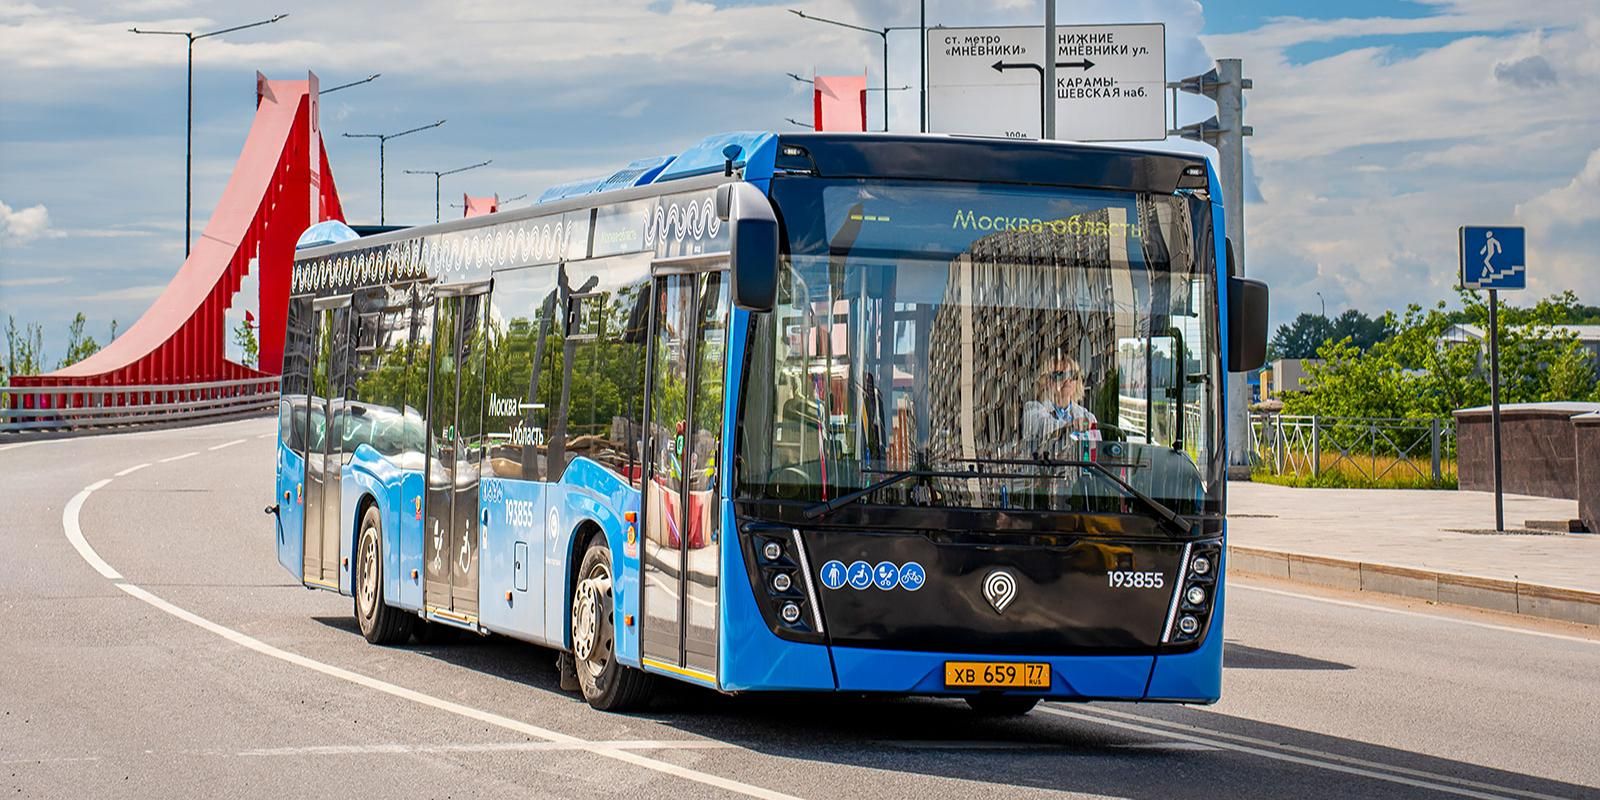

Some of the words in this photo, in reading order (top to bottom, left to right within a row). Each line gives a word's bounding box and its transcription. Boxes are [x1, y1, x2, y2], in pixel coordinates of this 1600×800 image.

[945, 36, 960, 44] ст.
[965, 35, 1000, 46] метро
[1058, 33, 1114, 44] НИЖНИЕ
[1132, 46, 1149, 57] ул.
[1057, 77, 1118, 88] КАРАМЫ-
[1057, 88, 1120, 99] ШЕВСКАЯ
[1124, 87, 1148, 98] наб.
[488, 392, 517, 417] Москва
[513, 419, 544, 446] область
[505, 498, 533, 528] 193855
[1107, 570, 1164, 589] 193855
[983, 665, 1017, 684] 659
[1027, 664, 1044, 680] 77
